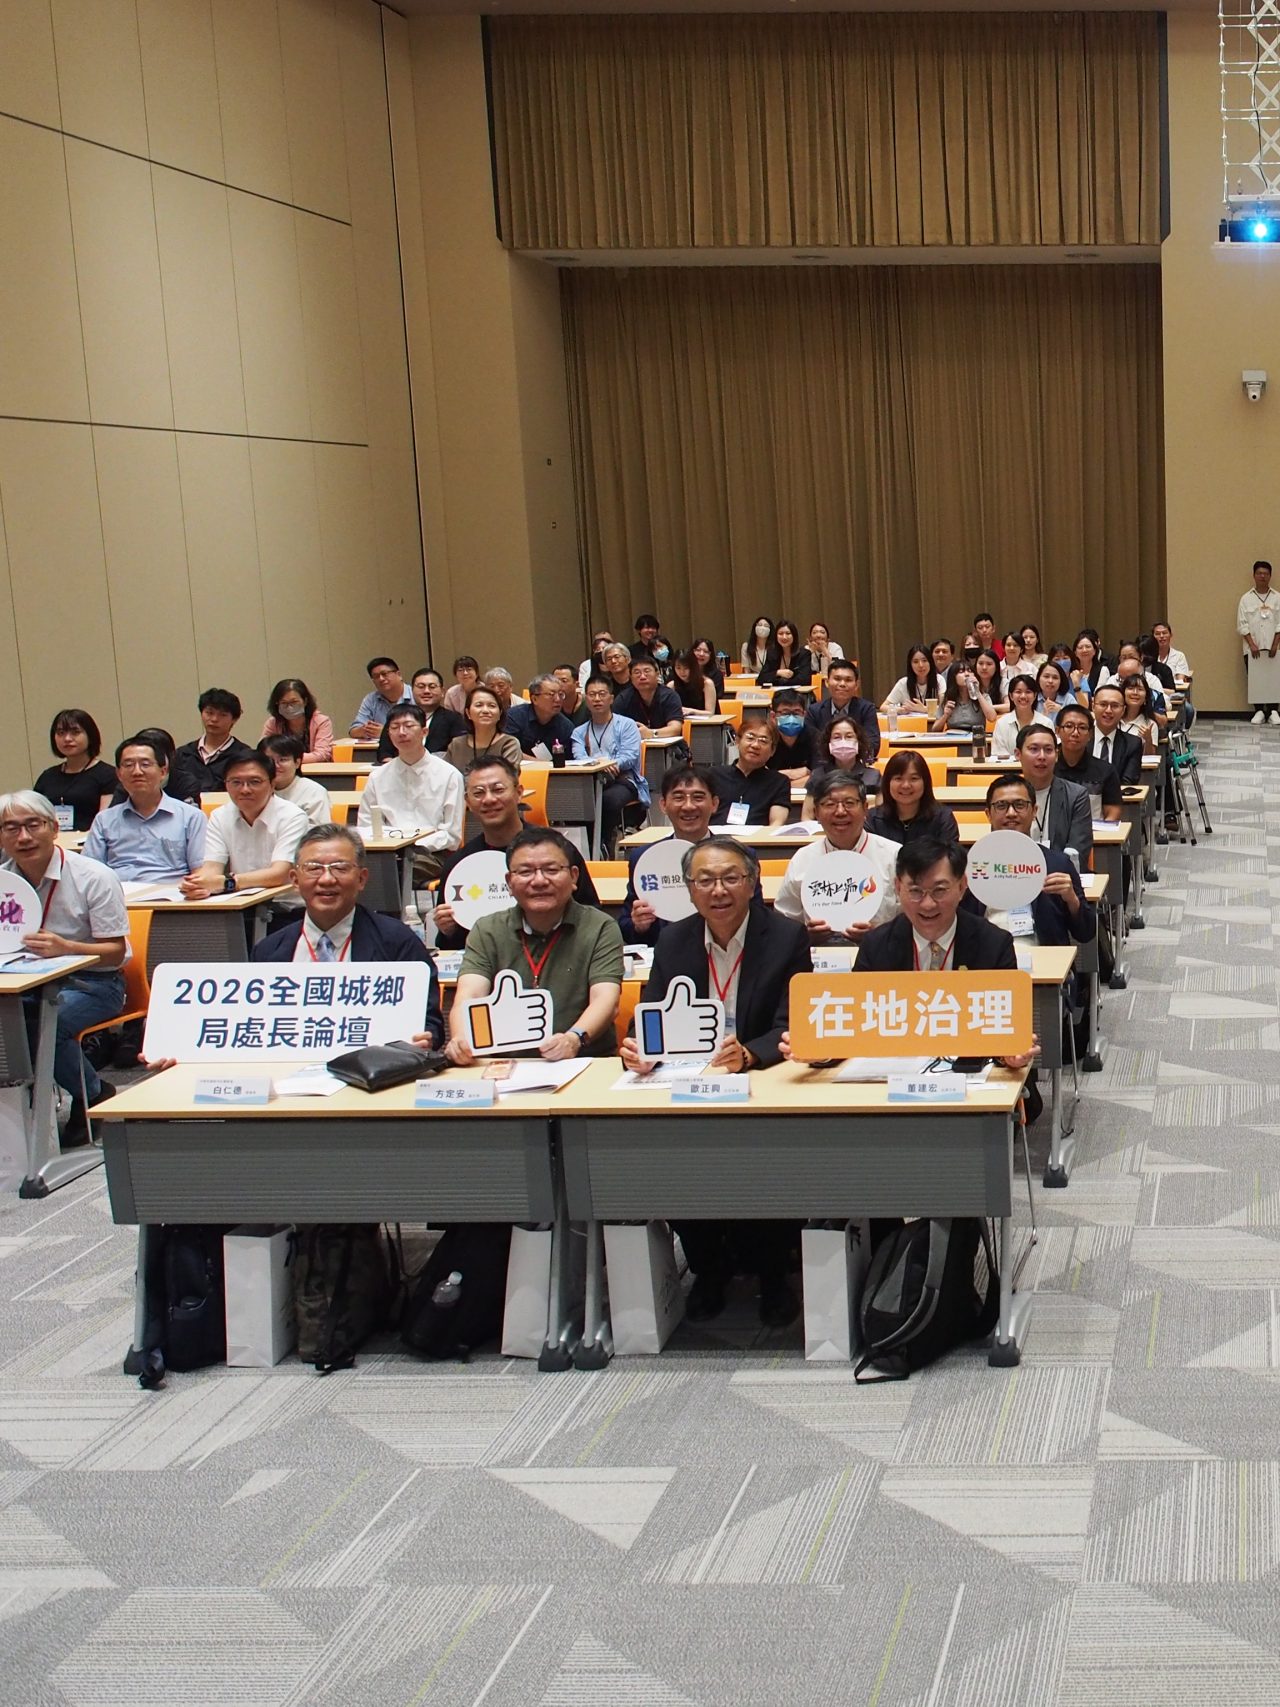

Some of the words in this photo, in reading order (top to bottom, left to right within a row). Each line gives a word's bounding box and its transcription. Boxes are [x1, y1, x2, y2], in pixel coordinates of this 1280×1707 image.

[661, 875, 683, 884] 南投
[994, 863, 1041, 875] KEELUNG
[173, 975, 406, 1007] 2026全國城鄉
[808, 989, 1015, 1039] 在地治理
[196, 1016, 373, 1049] 局處長論壇
[435, 1089, 465, 1099] 方定安
